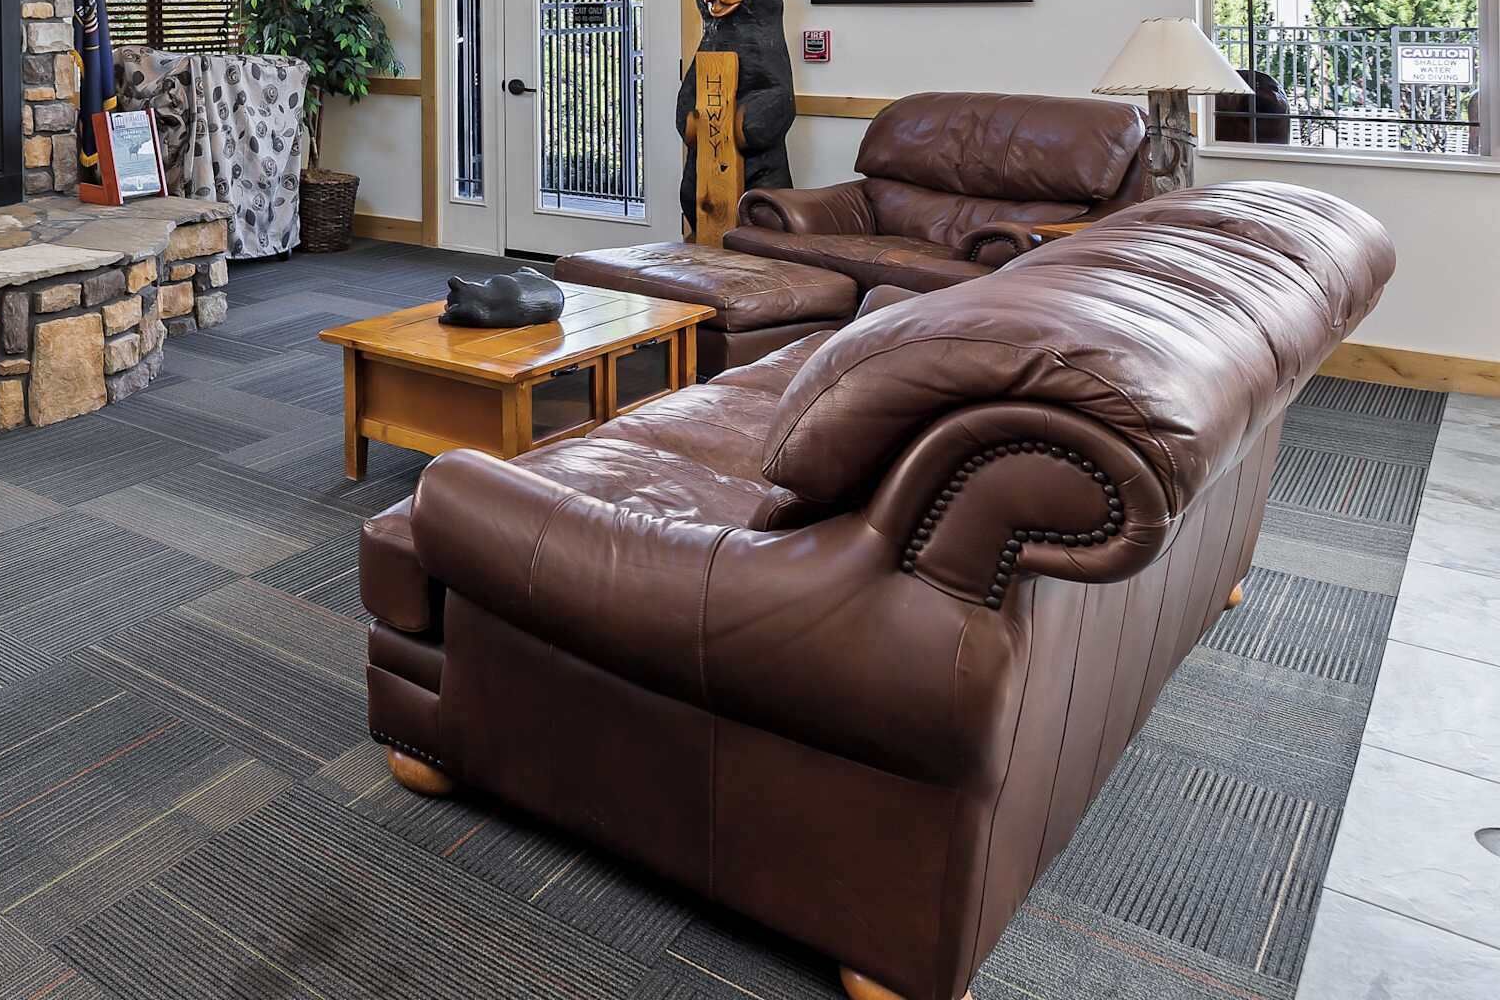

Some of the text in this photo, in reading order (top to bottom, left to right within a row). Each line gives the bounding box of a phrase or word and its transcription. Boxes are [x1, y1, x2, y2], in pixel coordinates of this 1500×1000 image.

[805, 31, 825, 40] FIRE
[1402, 48, 1469, 58] CAUTION
[706, 74, 722, 158] HOWDY
